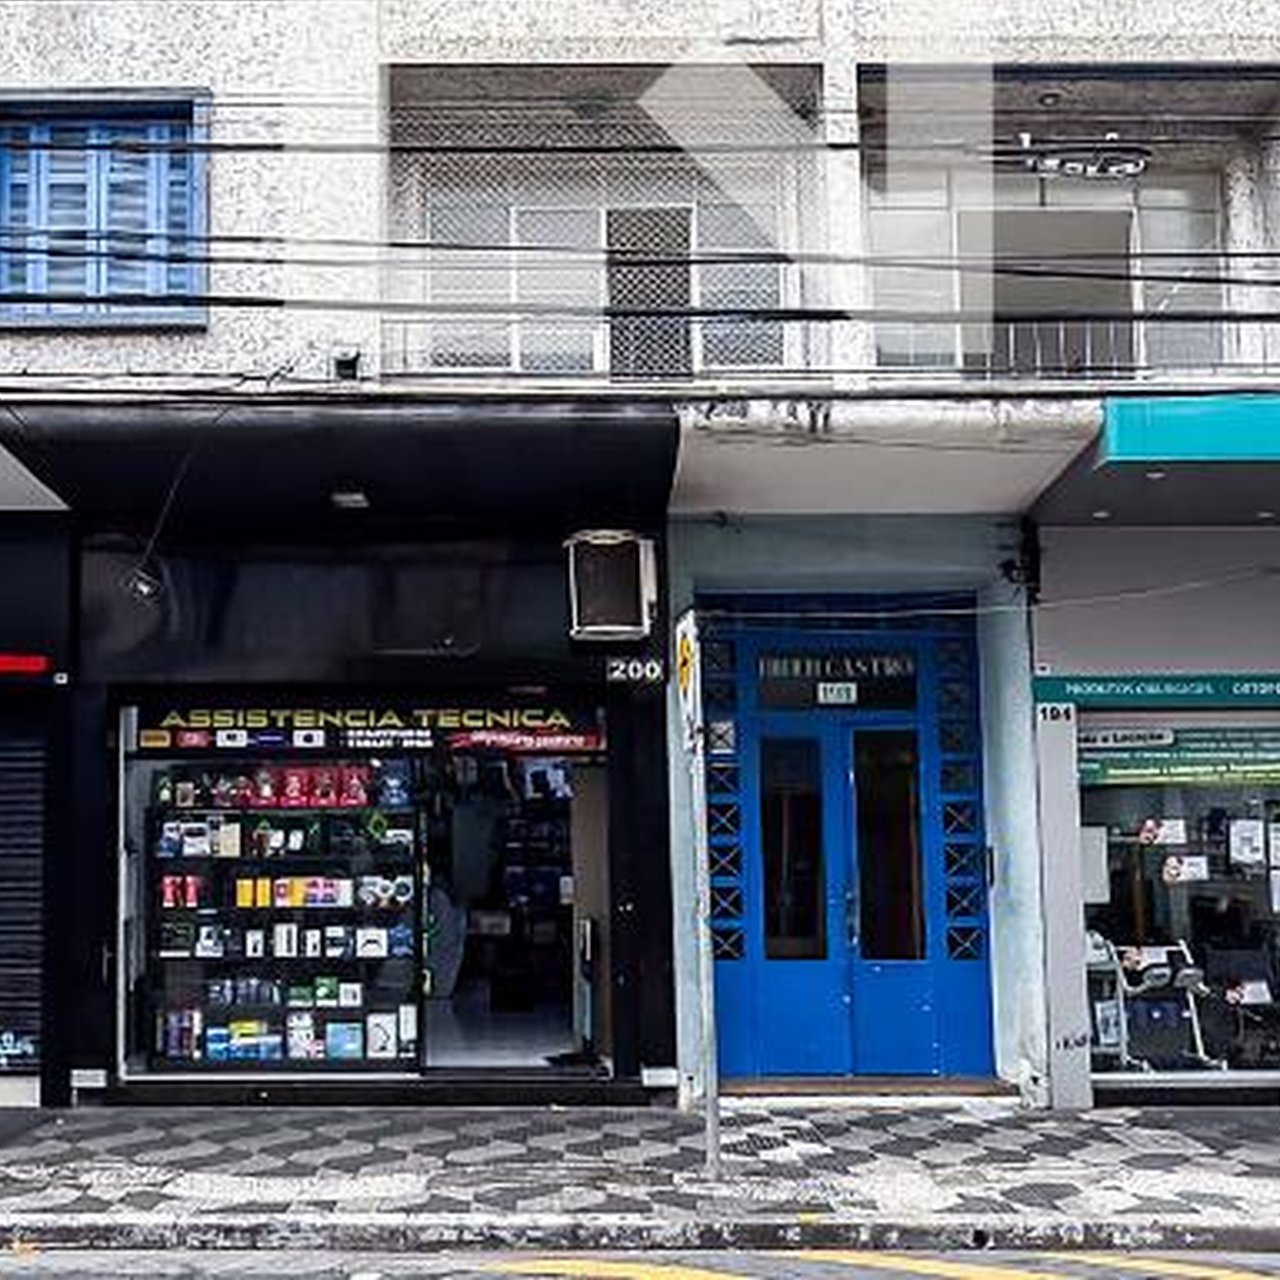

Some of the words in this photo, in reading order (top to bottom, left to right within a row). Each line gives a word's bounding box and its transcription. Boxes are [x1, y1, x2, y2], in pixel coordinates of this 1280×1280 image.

[609, 661, 662, 679] 200
[160, 709, 405, 728] ASSISTENCIA
[419, 709, 571, 728] TECNICA
